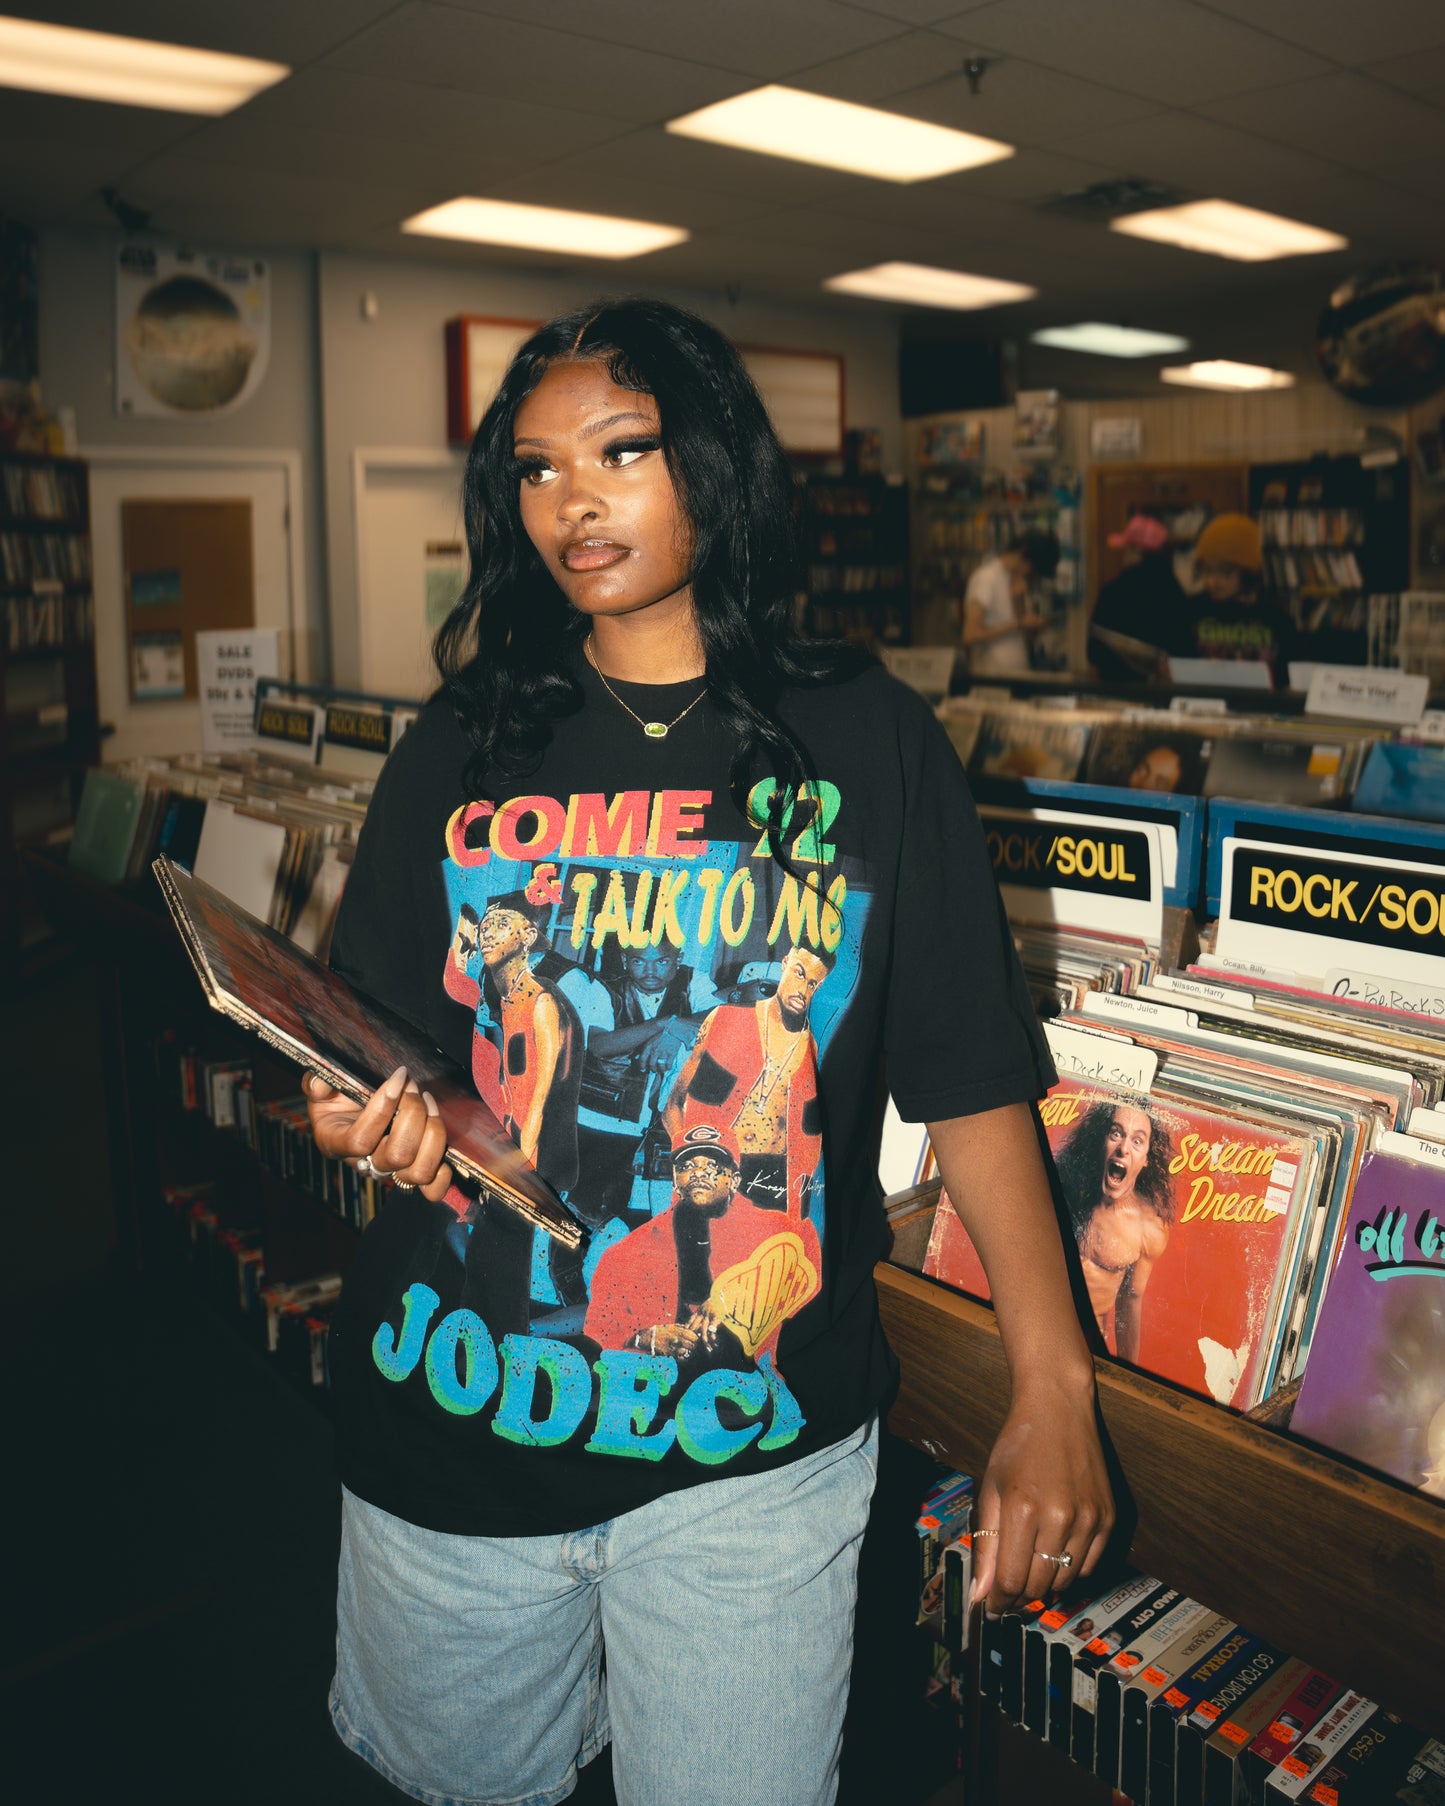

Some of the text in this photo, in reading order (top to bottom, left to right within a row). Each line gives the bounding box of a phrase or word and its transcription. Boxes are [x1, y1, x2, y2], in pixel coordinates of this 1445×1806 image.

[217, 645, 251, 659] SALE
[445, 789, 713, 868] COME
[524, 862, 565, 907] &
[570, 867, 691, 950] TALK
[697, 866, 756, 948] TO
[1222, 958, 1267, 975] Ocean, Billy
[1103, 996, 1159, 1015] Newton, Juice
[1171, 979, 1225, 999] Nilsson, Harry
[1169, 1133, 1278, 1177] Scream
[1418, 1140, 1439, 1155] The
[1180, 1175, 1279, 1225] Dream
[1130, 1589, 1179, 1629] MAD CITY
[1149, 1623, 1172, 1643] Hill
[1190, 1640, 1241, 1684] CORRAL
[1210, 1651, 1275, 1712] GO FOR BROKE
[1296, 1674, 1330, 1711] DEATH
[1346, 1726, 1387, 1766] Pesci
